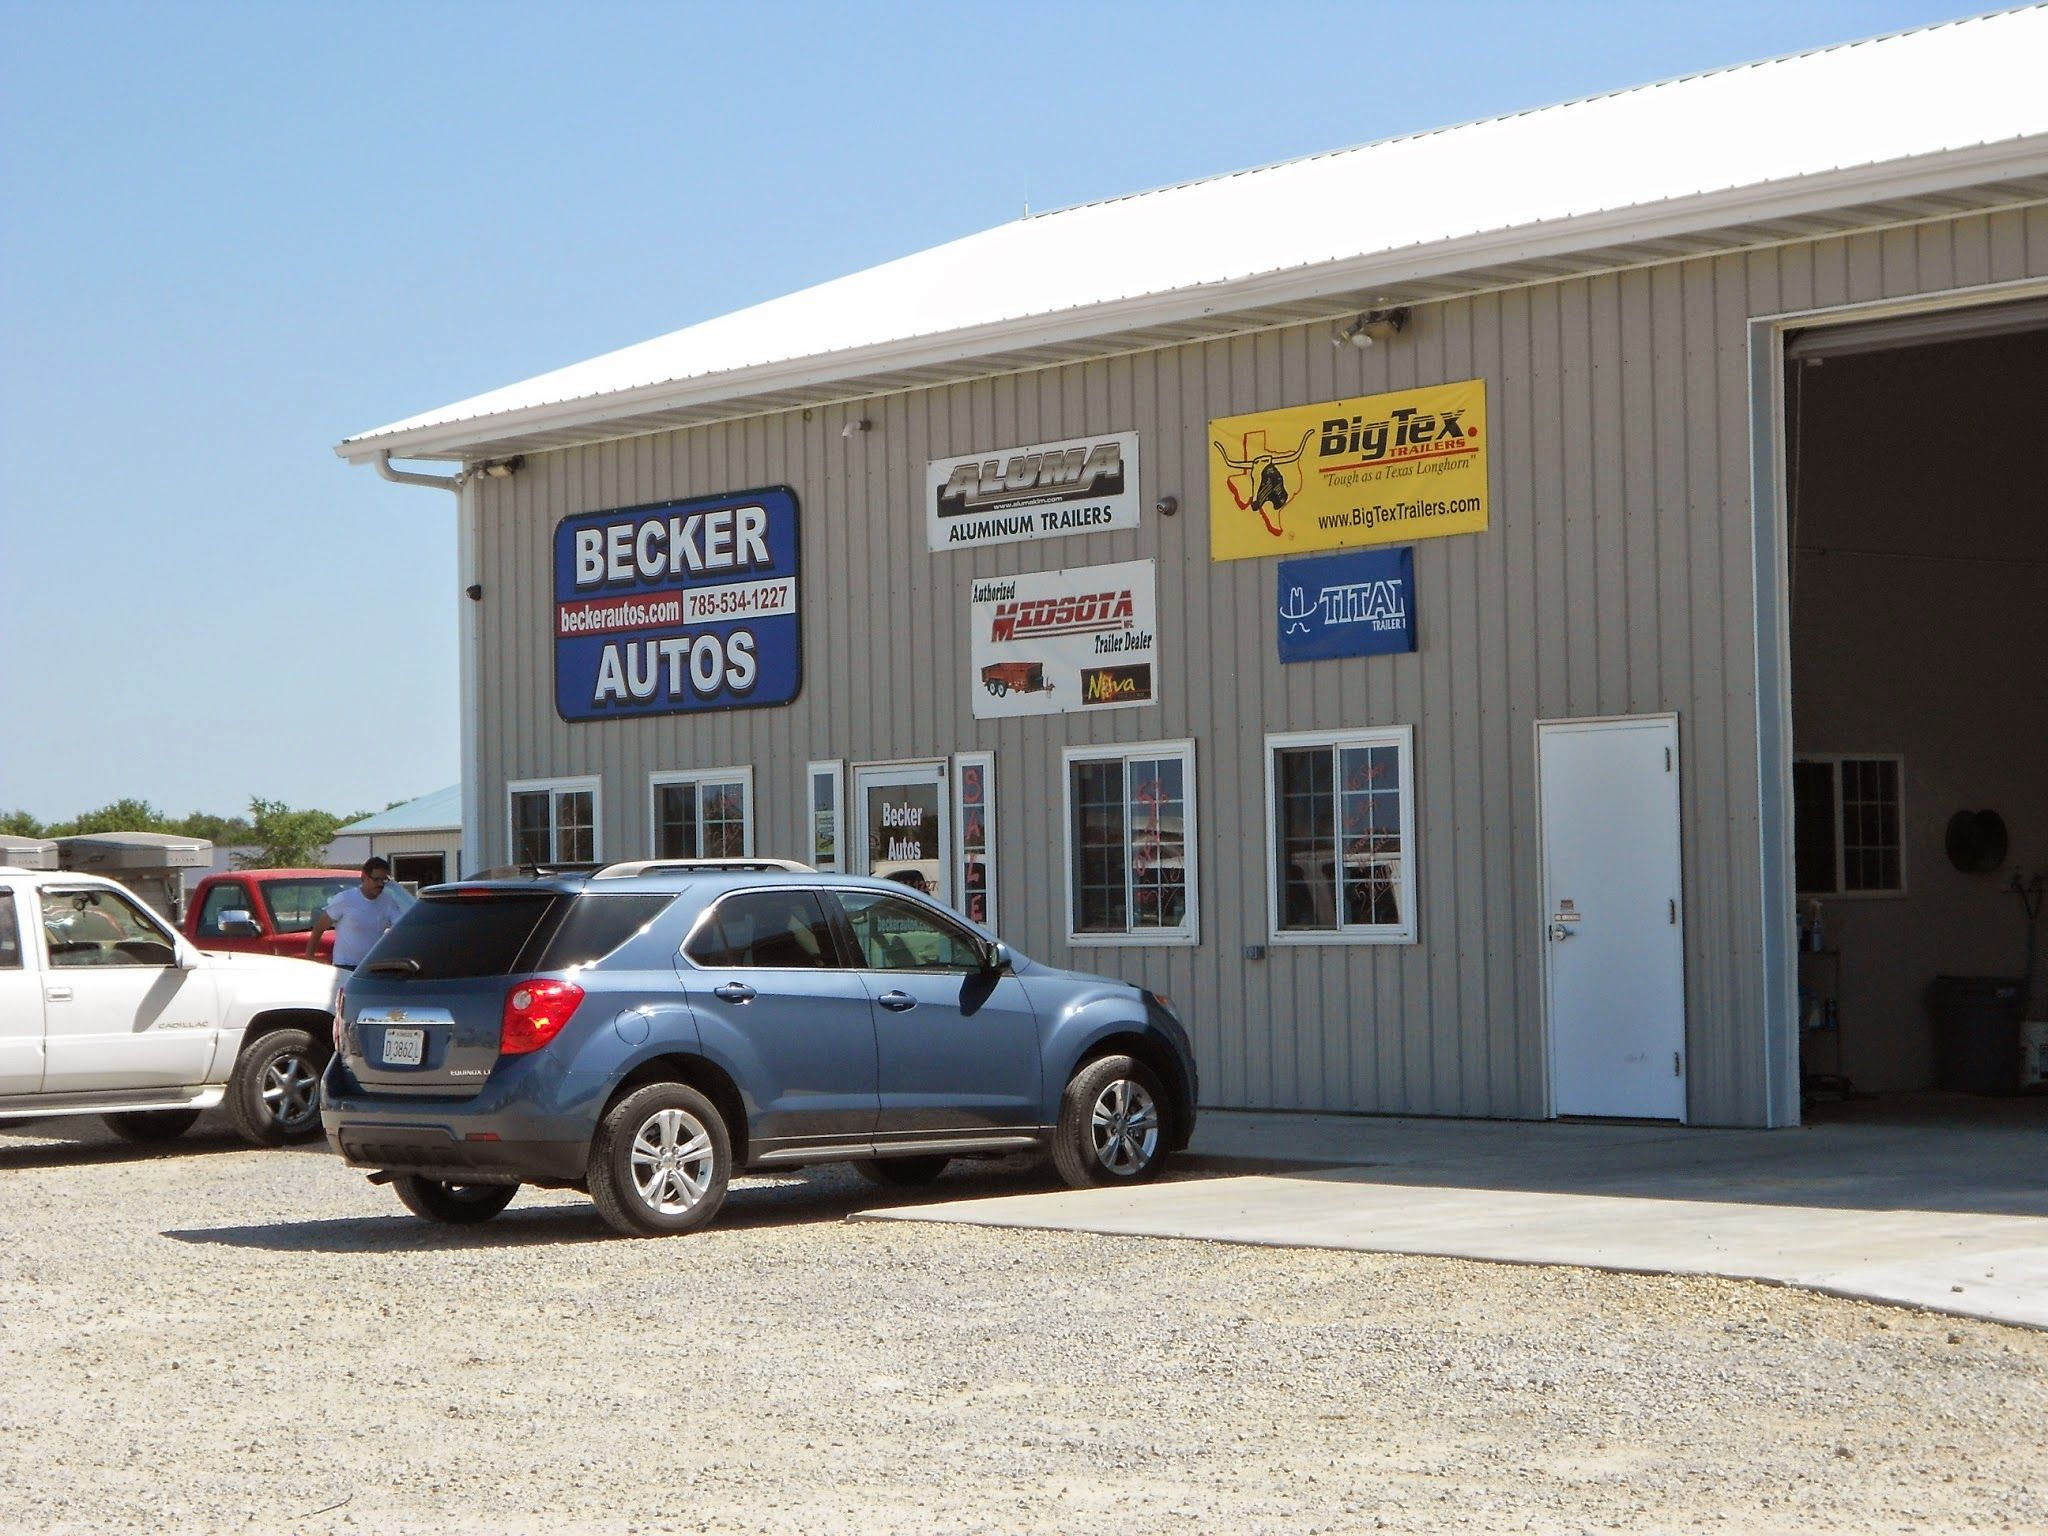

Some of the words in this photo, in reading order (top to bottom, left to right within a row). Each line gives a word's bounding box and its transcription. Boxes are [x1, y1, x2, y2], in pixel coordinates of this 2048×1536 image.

[1389, 439, 1466, 457] TRAILERS
[941, 442, 1121, 501] ALUMA
[1323, 470, 1359, 488] "Tough
[1361, 472, 1373, 482] as
[1375, 472, 1382, 480] a
[1385, 464, 1413, 479] Texas
[1416, 454, 1477, 475] Longhorn"
[949, 515, 1034, 542] ALUMINUM
[1041, 505, 1112, 531] TRAILERS
[1318, 497, 1481, 529] www.BigTexTrailers.com
[576, 506, 769, 585] BECKER
[973, 580, 1016, 603] Authorized
[561, 600, 679, 633] beckerautos.com
[690, 586, 787, 616] 785-534-1227
[991, 590, 1133, 642] MIDSOTA
[1094, 634, 1123, 654] Trailer
[1124, 630, 1152, 651] Dealer
[1372, 620, 1401, 632] TRAILER
[594, 631, 756, 700] AUTOS
[882, 802, 923, 827] Becker
[888, 836, 921, 861] Autos
[158, 1021, 208, 1029] CADILLAC
